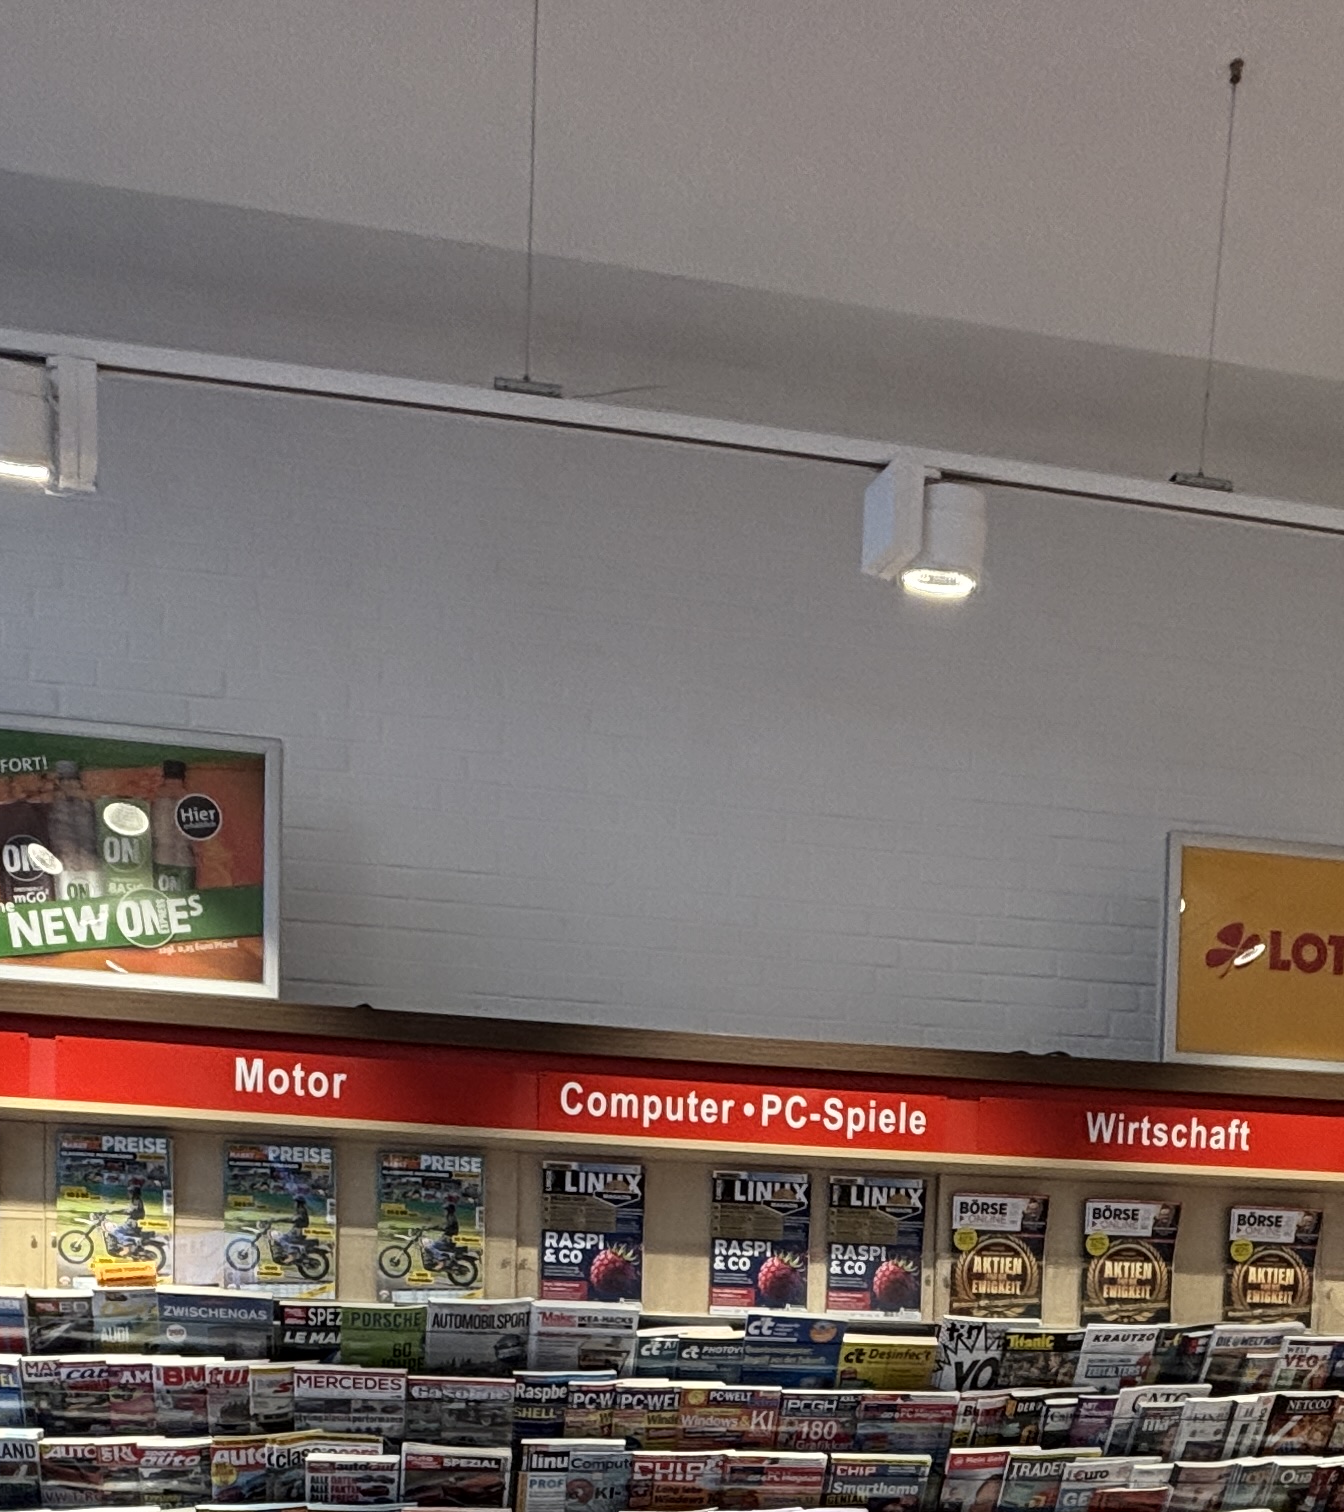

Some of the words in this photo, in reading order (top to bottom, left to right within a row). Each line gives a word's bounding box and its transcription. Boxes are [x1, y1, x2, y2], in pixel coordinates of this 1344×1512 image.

[179, 806, 216, 822] Hier
[8, 903, 109, 948] NEW
[234, 1057, 347, 1100] Motor
[559, 1081, 736, 1129] Computer
[759, 1092, 928, 1138] PC-Spiele
[1084, 1111, 1251, 1154] Wirtschaft
[101, 1136, 167, 1154] PREISE
[268, 1145, 332, 1163] PREISE
[420, 1154, 482, 1172] PREISE
[564, 1171, 642, 1194] LINUX
[733, 1180, 808, 1201] LINUX
[959, 1201, 1008, 1216] BÖRSE
[1092, 1207, 1140, 1221] BÖRSE
[544, 1232, 604, 1249] RASPI
[714, 1239, 771, 1257] RASPI
[559, 1248, 583, 1264] CO
[728, 1256, 751, 1271] CO
[972, 1256, 1023, 1275] AKTIEN
[1104, 1260, 1153, 1279] AKTIEN
[163, 1305, 268, 1321] ZWISCHENGAS
[350, 1310, 423, 1327] PORSCHE
[432, 1312, 531, 1330] AUTOMOBILSPORT
[296, 1373, 402, 1391] MERCEDES
[800, 1421, 838, 1440] 180
